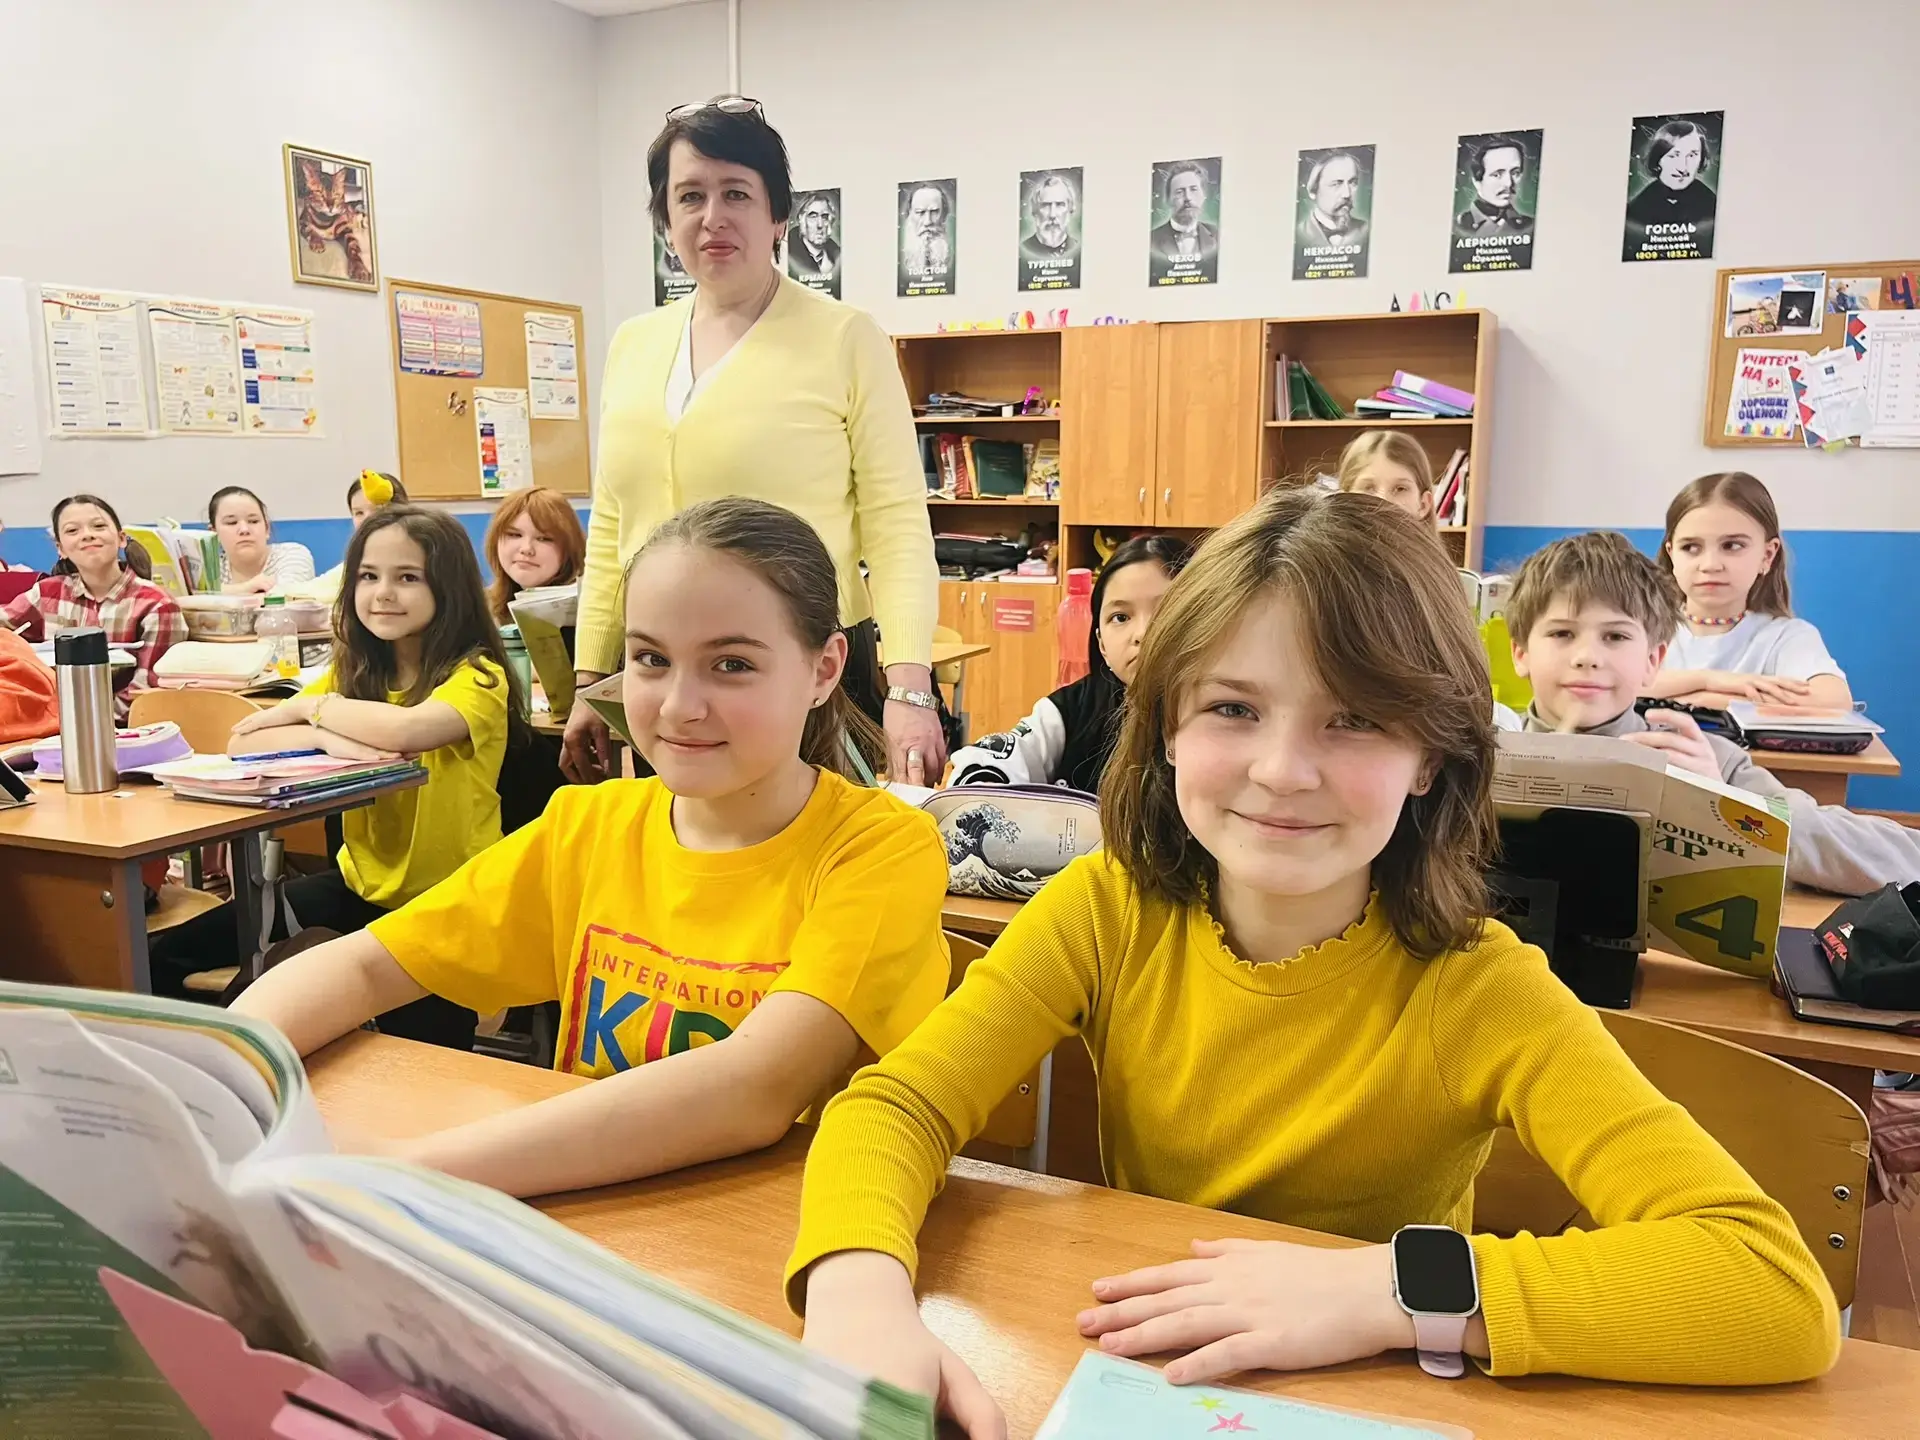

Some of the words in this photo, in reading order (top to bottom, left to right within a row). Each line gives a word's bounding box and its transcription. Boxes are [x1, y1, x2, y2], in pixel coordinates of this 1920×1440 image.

[1645, 222, 1697, 235] ГОГОЛЬ
[1456, 235, 1531, 249] ЛЕРМОНТОВ
[1650, 234, 1690, 243] Николай
[1303, 245, 1361, 256] НЕКРАСОВ
[1476, 247, 1509, 255] Михаил
[1641, 242, 1697, 251] Васильевич
[1027, 258, 1074, 269] ТУРГЕНЕВ
[1168, 253, 1202, 263] ЧЕХОВ
[1472, 255, 1512, 263] Юрьевич
[908, 263, 948, 275] ТОЛСТОЙ
[799, 272, 832, 282] КРЫЛОВ
[1742, 366, 1762, 381] НА
[1741, 397, 1789, 407] ХОРОШИХ
[1738, 409, 1788, 420] ОЦЕНОК!
[1674, 895, 1765, 961] 4
[592, 948, 767, 1009] INTERATION
